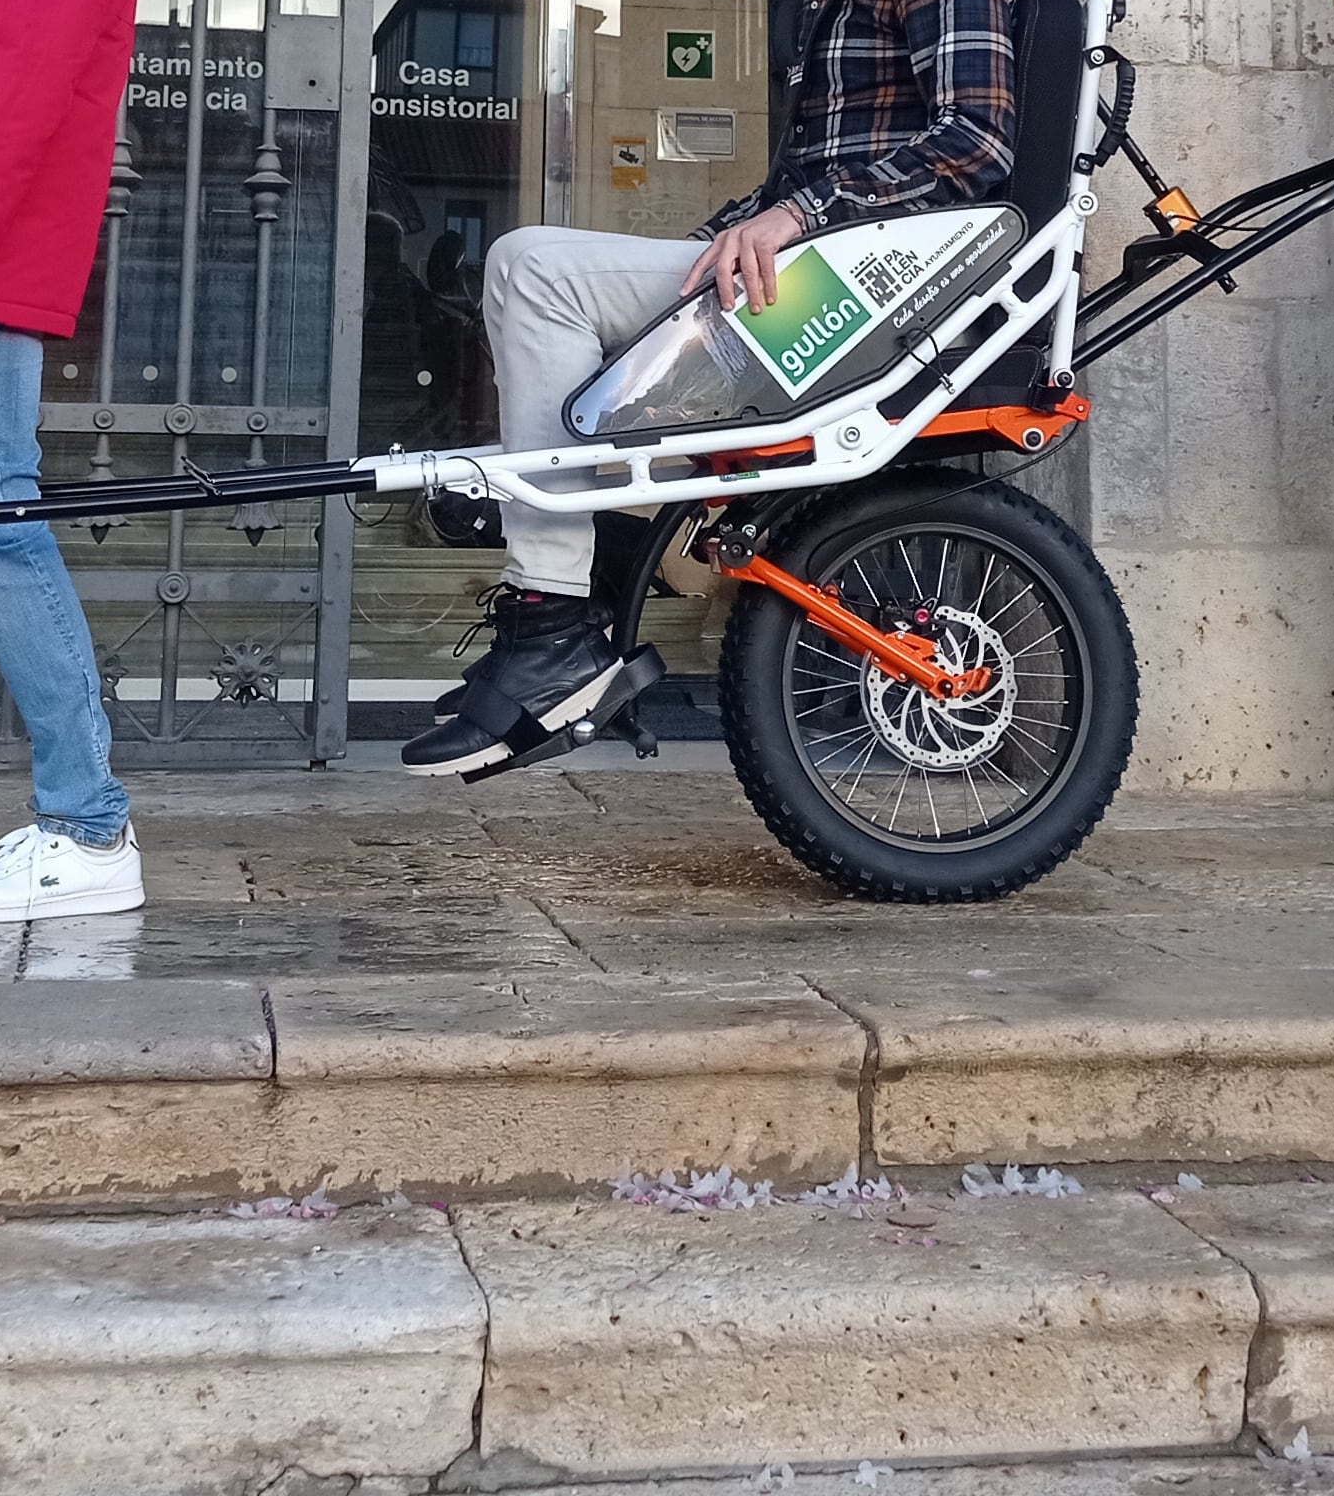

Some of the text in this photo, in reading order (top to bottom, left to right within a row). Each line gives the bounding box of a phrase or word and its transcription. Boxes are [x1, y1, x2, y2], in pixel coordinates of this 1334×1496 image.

[398, 60, 470, 87] Casa
[127, 83, 247, 111] Palecia
[371, 94, 518, 120] onsistorial
[883, 249, 903, 266] PA
[891, 250, 918, 276] LEN
[901, 221, 974, 285] CIA AYUNTAMIENTO
[893, 307, 915, 328] Cada
[940, 276, 950, 288] es
[949, 264, 965, 280] una
[781, 299, 861, 377] gullón
